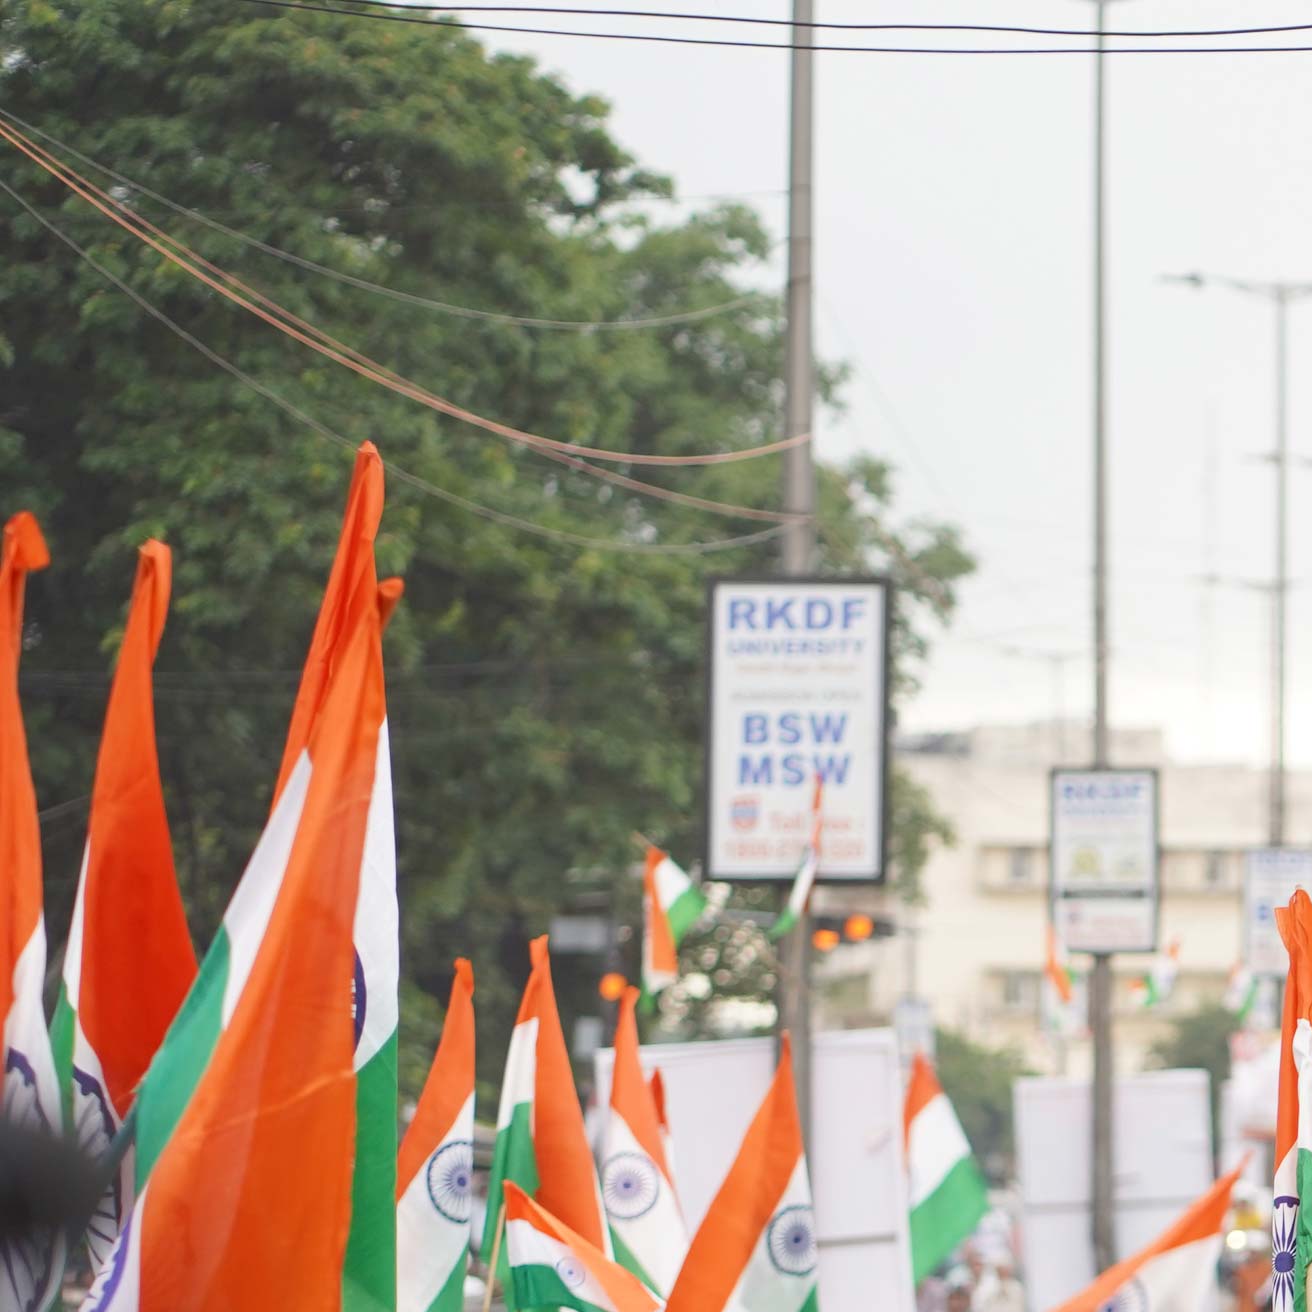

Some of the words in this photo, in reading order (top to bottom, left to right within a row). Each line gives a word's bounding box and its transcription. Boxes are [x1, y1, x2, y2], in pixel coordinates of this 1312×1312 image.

[727, 598, 866, 630] RKDF
[727, 639, 865, 656] UNIVERSITY
[743, 713, 848, 745] BSW
[738, 754, 853, 786] MSW
